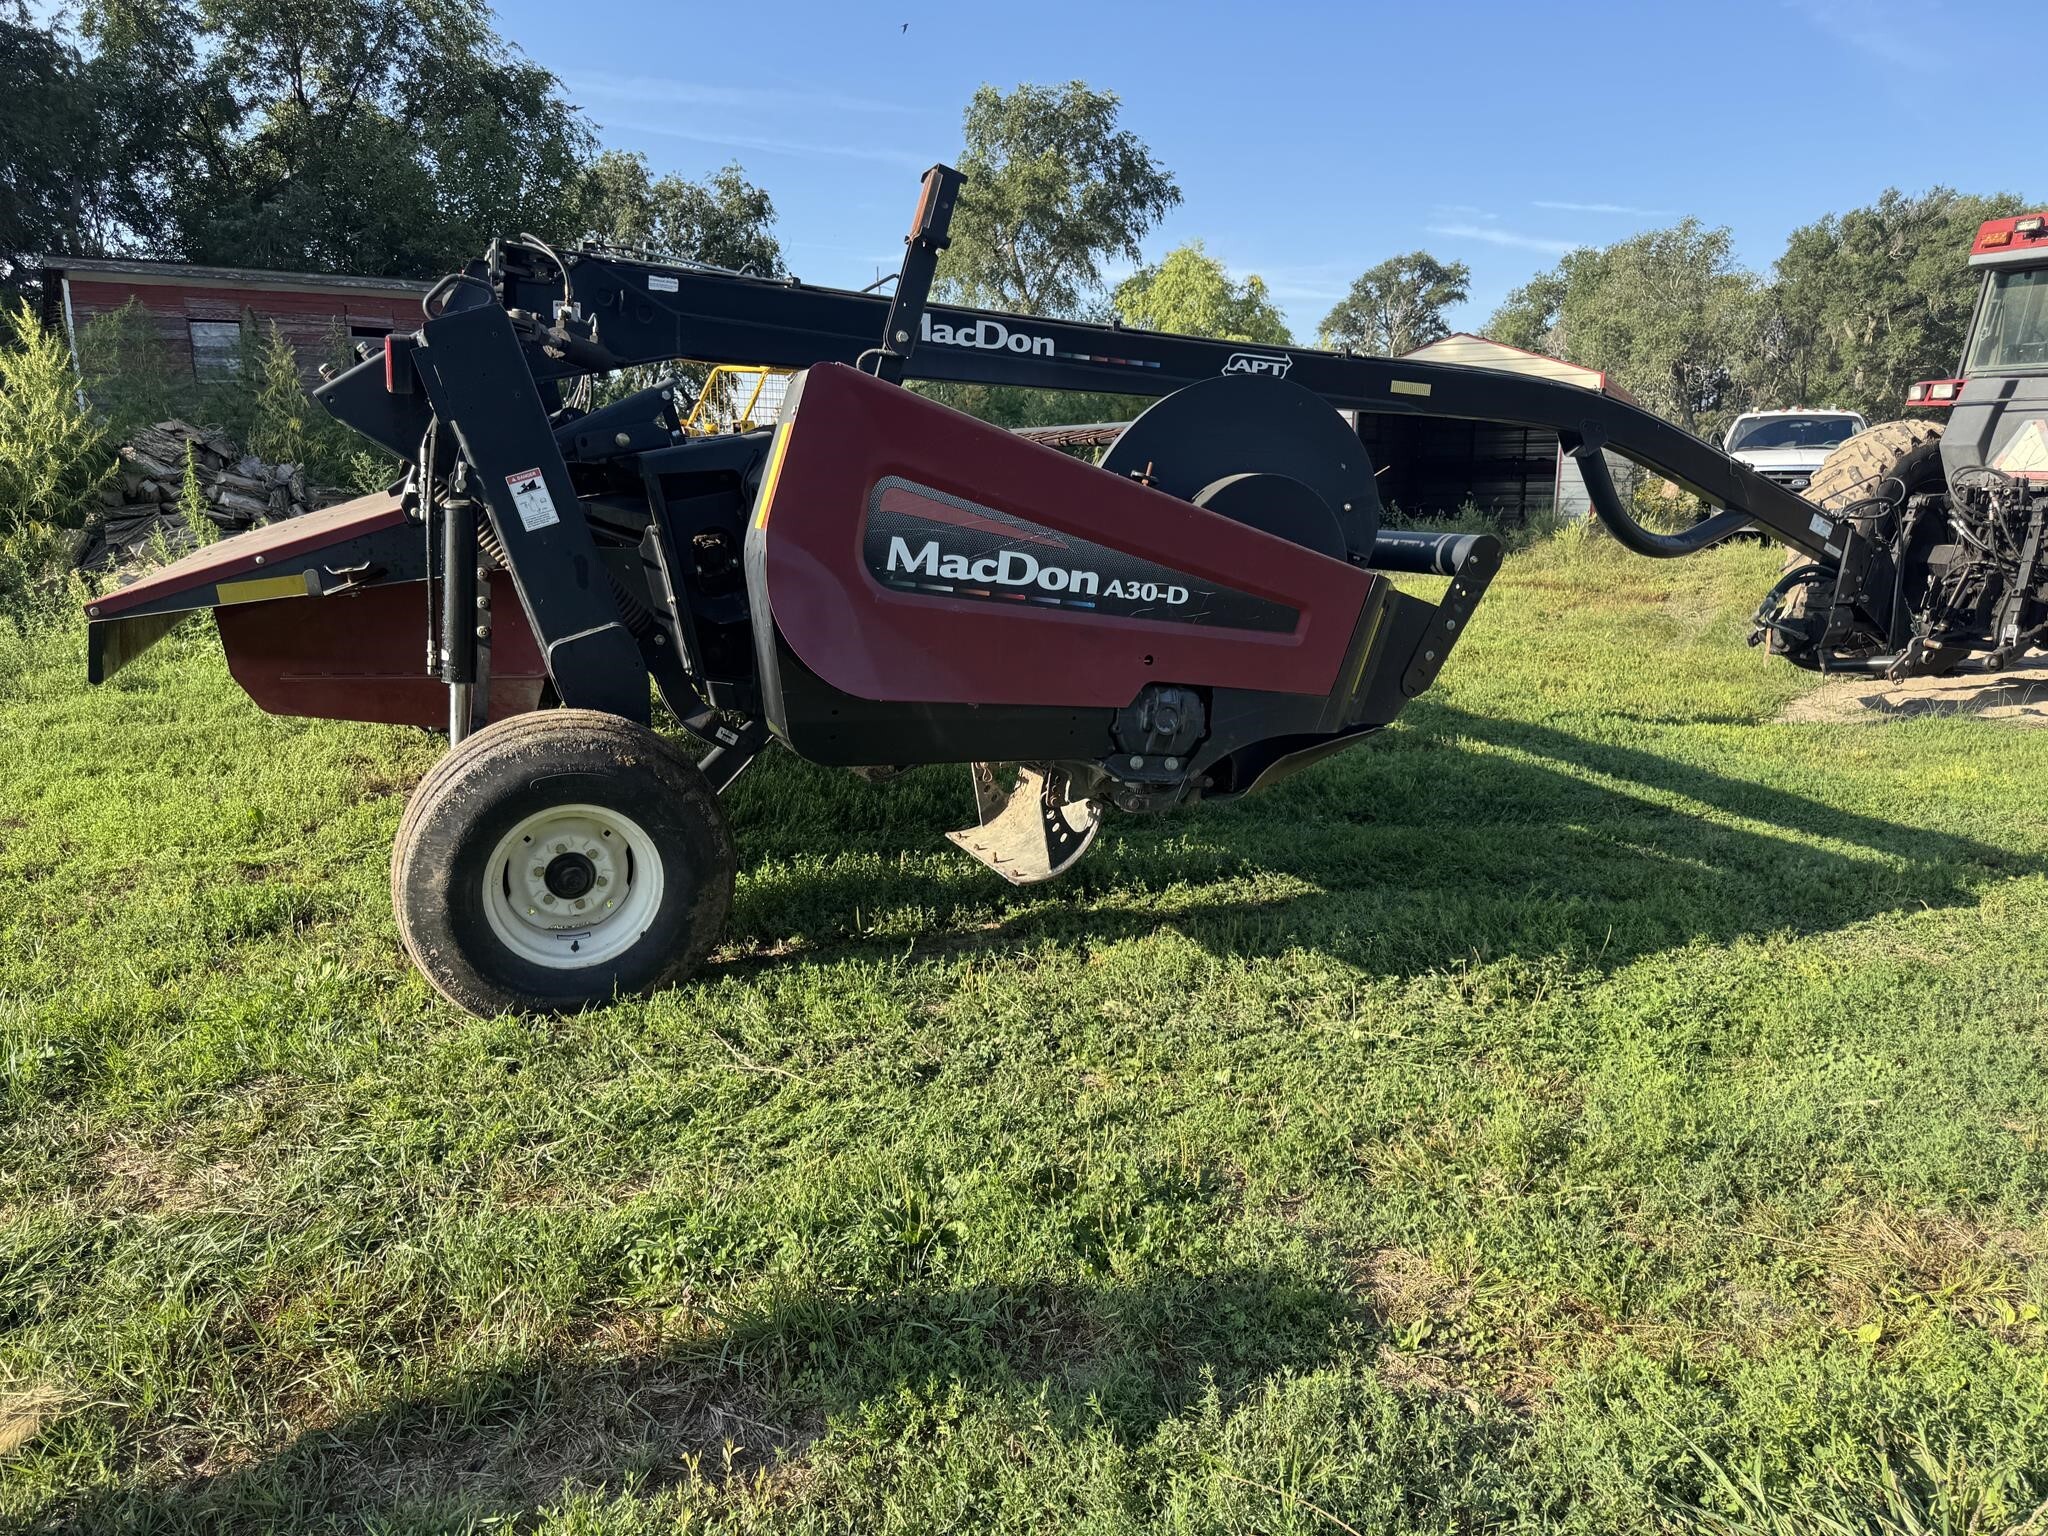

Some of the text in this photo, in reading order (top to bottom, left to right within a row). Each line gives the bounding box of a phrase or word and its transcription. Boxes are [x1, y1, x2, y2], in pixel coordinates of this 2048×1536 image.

[1227, 358, 1287, 377] APT
[516, 471, 537, 480] DANGER
[886, 536, 1190, 606] MacDon A30-D
